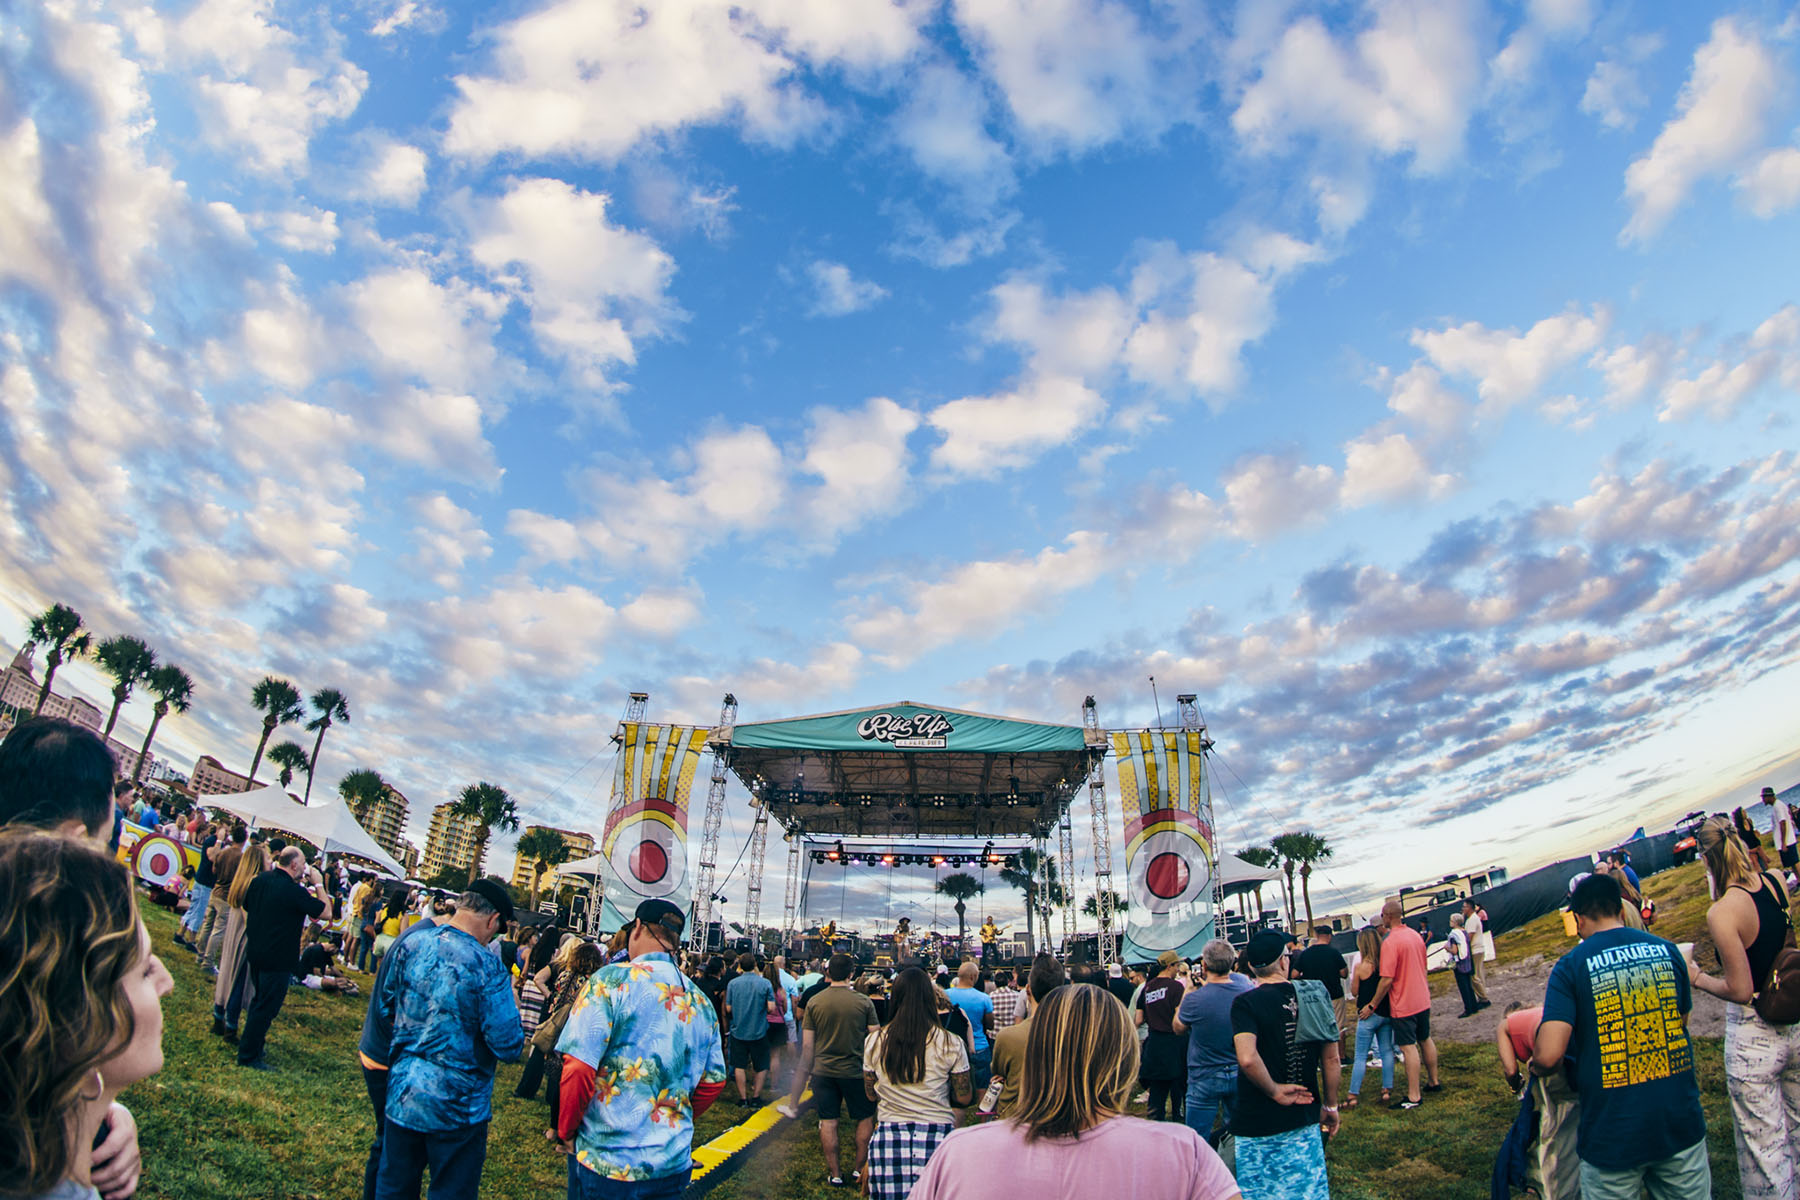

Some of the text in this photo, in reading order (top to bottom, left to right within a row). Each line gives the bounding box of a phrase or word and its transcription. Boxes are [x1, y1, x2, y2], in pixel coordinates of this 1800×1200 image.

[857, 713, 950, 740] Rise Up
[1593, 988, 1618, 1000] TREY
[1597, 1010, 1623, 1025] GOOSE
[1600, 1041, 1627, 1054] SMINO
[1602, 1062, 1628, 1074] LES
